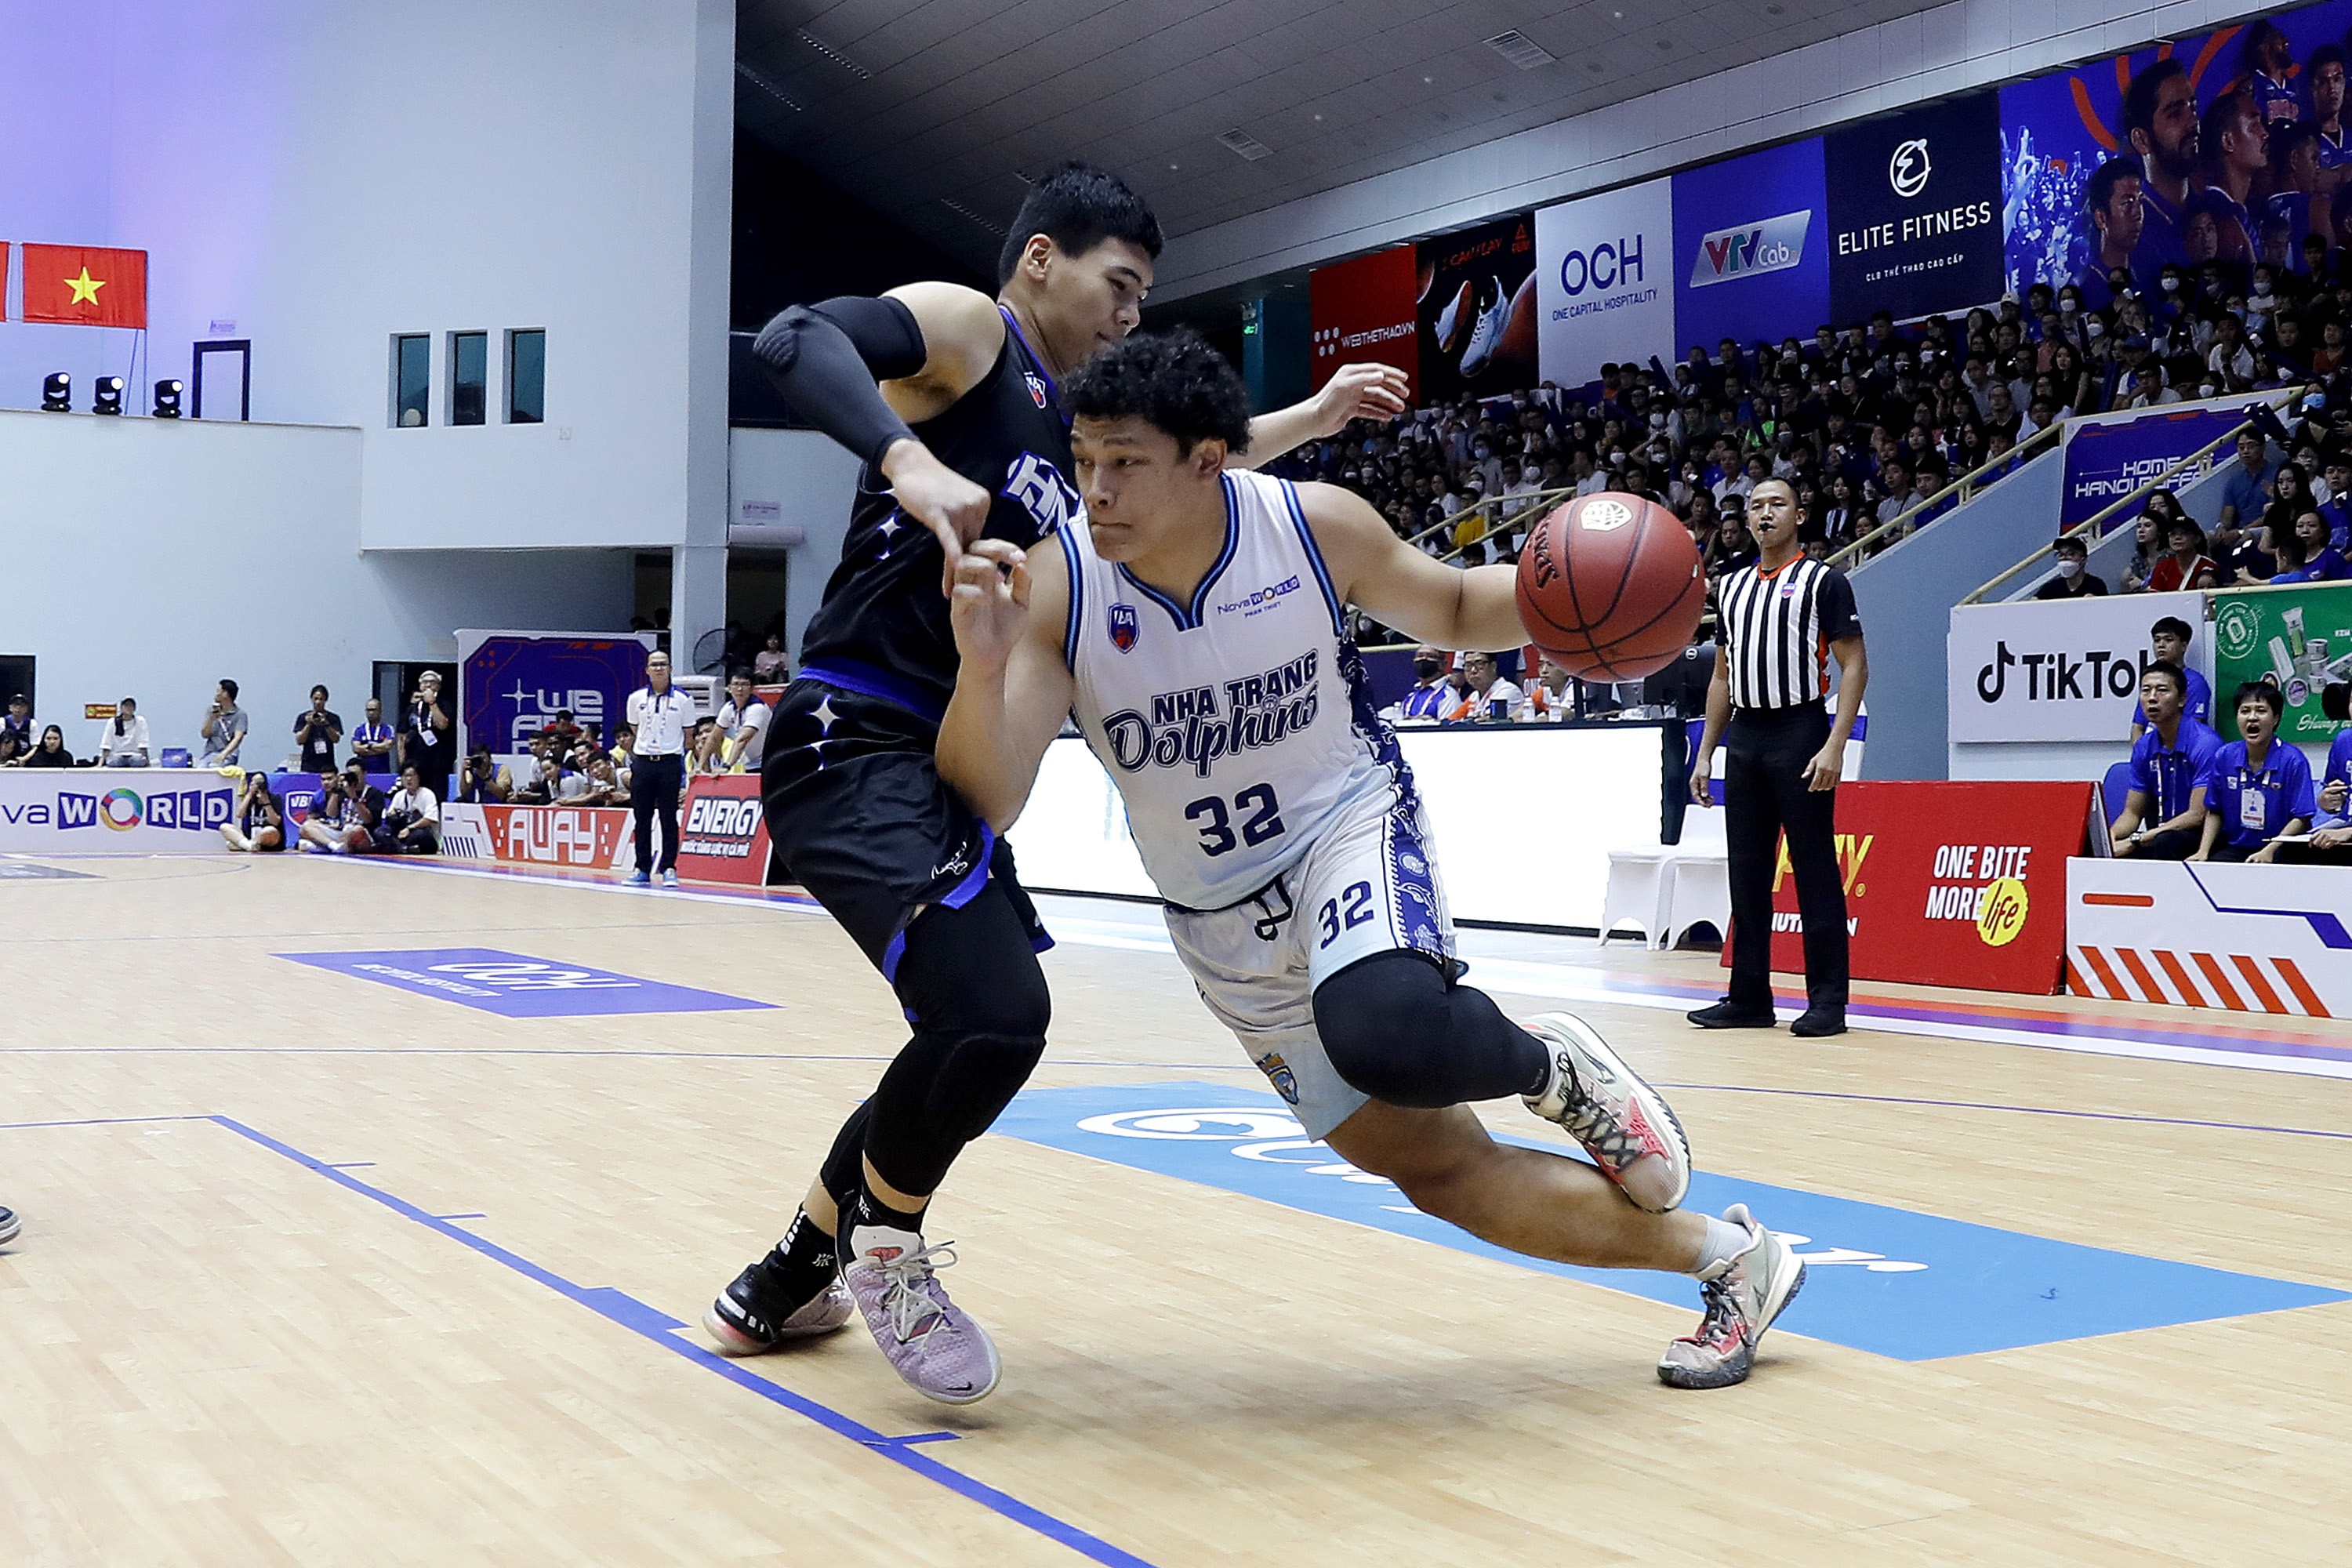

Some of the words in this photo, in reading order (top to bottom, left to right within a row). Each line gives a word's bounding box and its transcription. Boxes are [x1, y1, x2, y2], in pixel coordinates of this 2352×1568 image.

[1838, 223, 1894, 255] ELITE
[1903, 201, 1991, 241] FITNESS
[1561, 234, 1643, 296] OCH
[1866, 271, 1881, 281] CLB
[1903, 263, 1924, 274] THAO
[1927, 259, 1944, 269] CAO
[1552, 307, 1569, 321] ONE
[1570, 299, 1602, 317] CAPITAL
[1605, 289, 1657, 310] HOSPITALITY
[2075, 477, 2134, 498] HANOI
[2122, 456, 2181, 477] HOME
[1152, 685, 1219, 728] NHA
[1223, 648, 1319, 710] TRANG
[1102, 681, 1319, 779] Dolphins
[509, 810, 597, 862] AWAY
[686, 799, 763, 837] ENERGY
[1185, 783, 1285, 857] 32
[1933, 844, 1978, 879] ONE
[1979, 846, 2032, 880] BITE
[1318, 880, 1374, 949] 32
[1925, 886, 1989, 920] MORE
[1984, 882, 2020, 940] life
[428, 963, 641, 991] OCH
